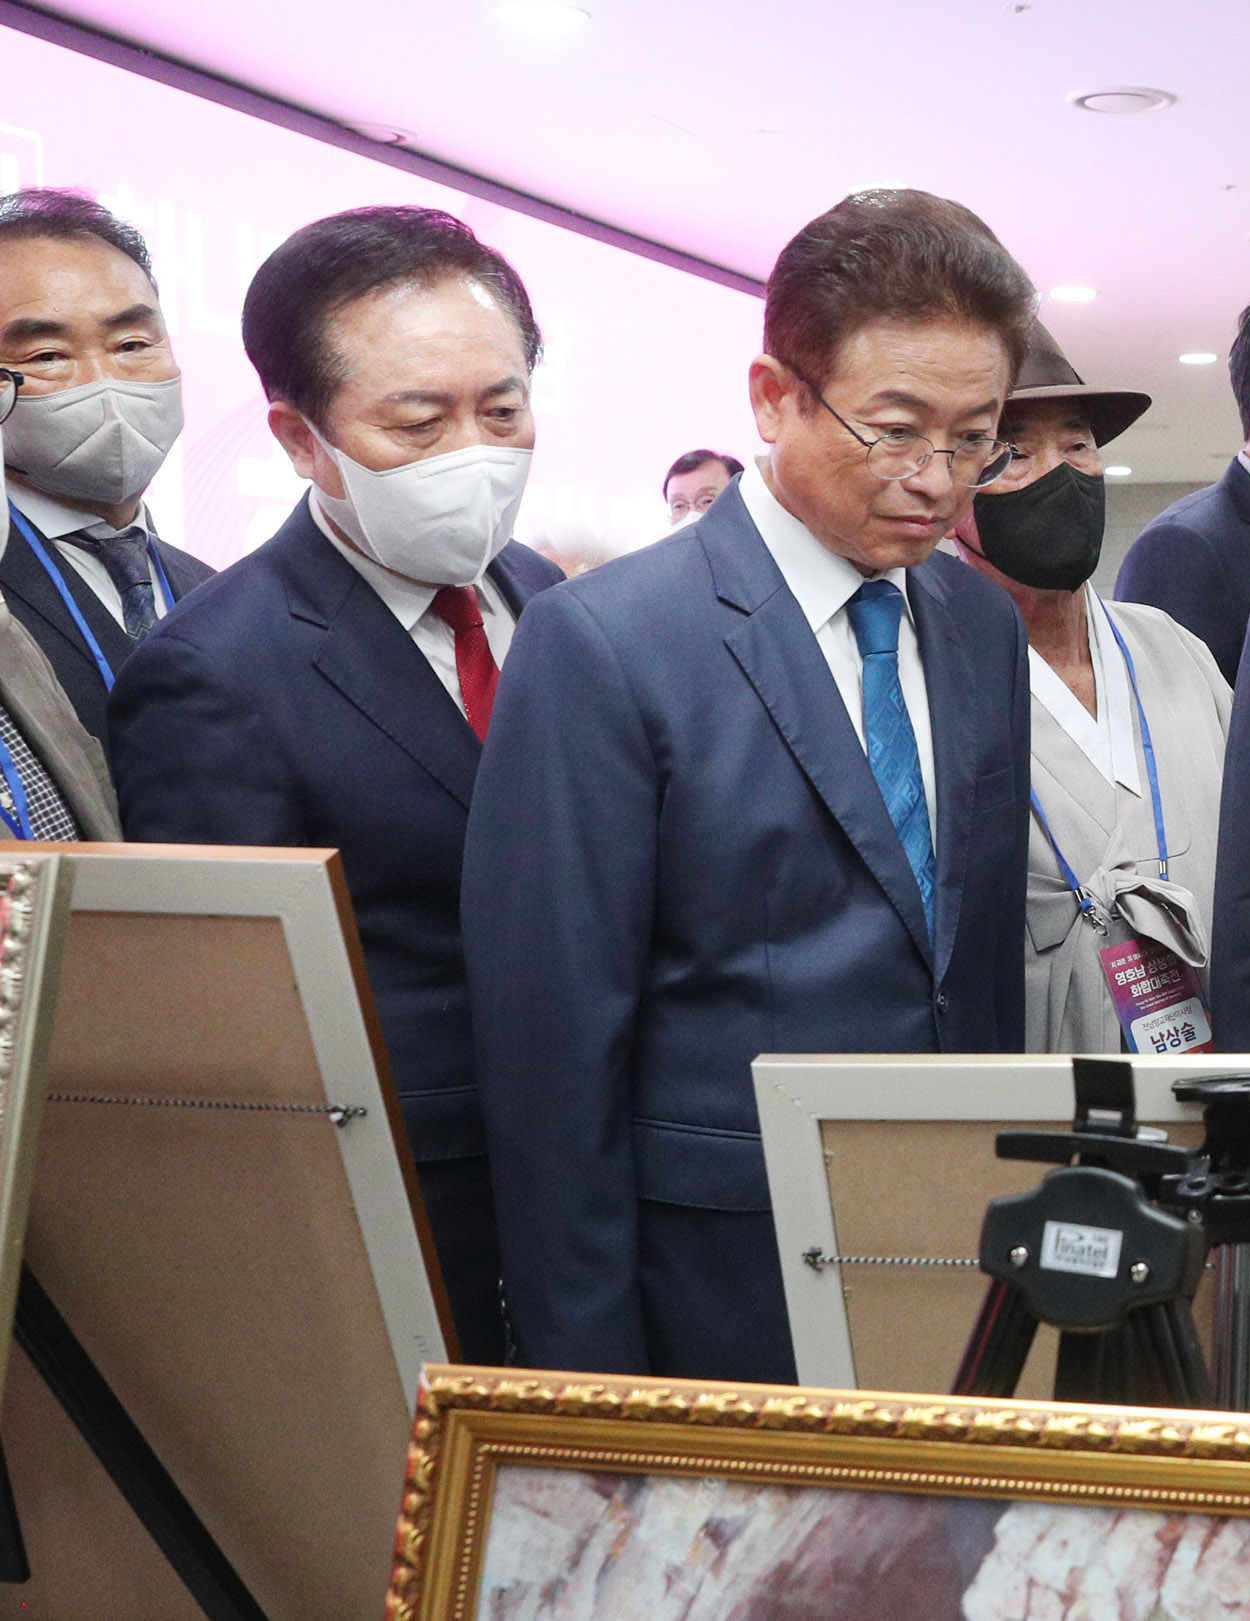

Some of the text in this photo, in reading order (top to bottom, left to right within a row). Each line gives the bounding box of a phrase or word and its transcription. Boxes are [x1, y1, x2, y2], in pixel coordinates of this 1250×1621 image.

[1114, 964, 1146, 986] 영호남
[1129, 968, 1181, 998] 화합대축전
[1150, 1022, 1197, 1054] 남상술
